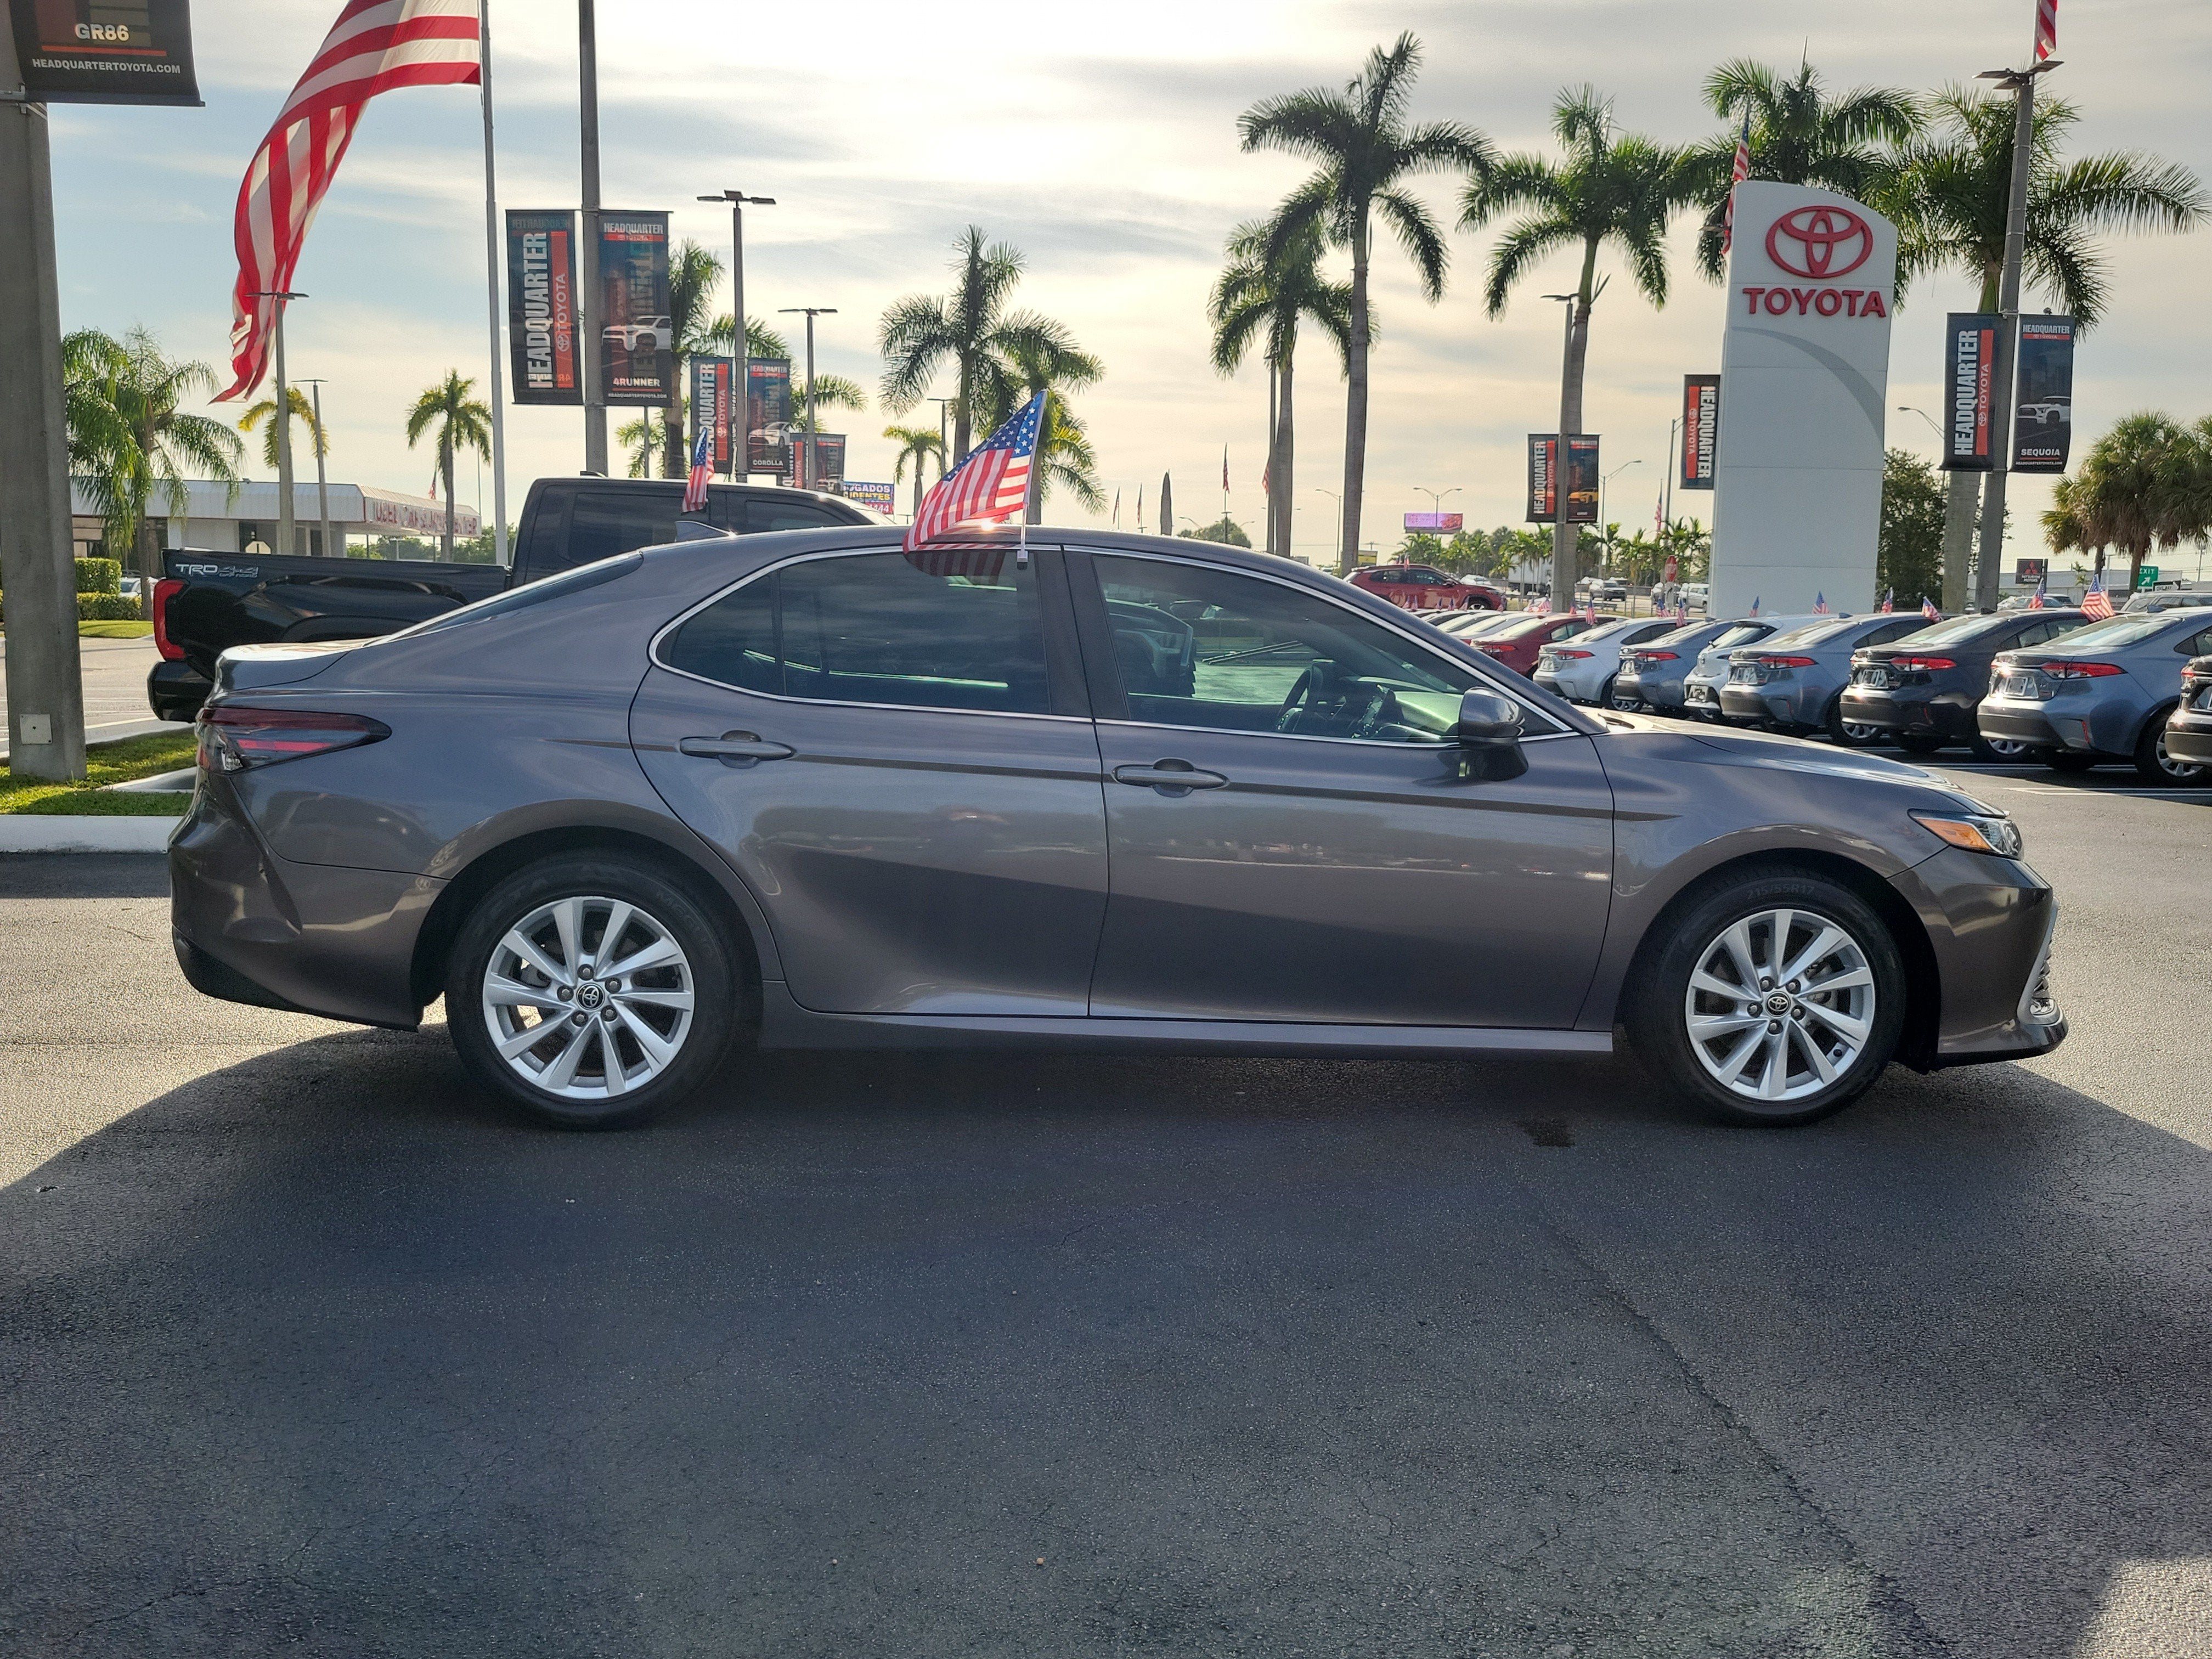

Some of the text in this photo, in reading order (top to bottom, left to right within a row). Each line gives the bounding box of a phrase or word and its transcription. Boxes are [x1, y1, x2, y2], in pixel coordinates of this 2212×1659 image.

[75, 24, 129, 41] GR86
[32, 59, 181, 74] HEADQUARTERTOYOTA.COM
[604, 223, 663, 234] HEADQUARTER
[523, 232, 554, 388] HEADQUARTER
[556, 274, 568, 332] TOYOTA
[1742, 287, 1886, 318] TOYOTA
[2023, 324, 2070, 334] HEADQUARTER
[613, 377, 661, 387] 4RUNNER
[1954, 330, 1978, 455] HEADQUARTER
[1979, 363, 1989, 411] TOYOTA
[1697, 386, 1716, 478] HEADQUARTER
[1533, 441, 1547, 514] HEADQUARTER
[176, 563, 218, 575] TRD
[1747, 884, 1815, 900] 215/55R17
